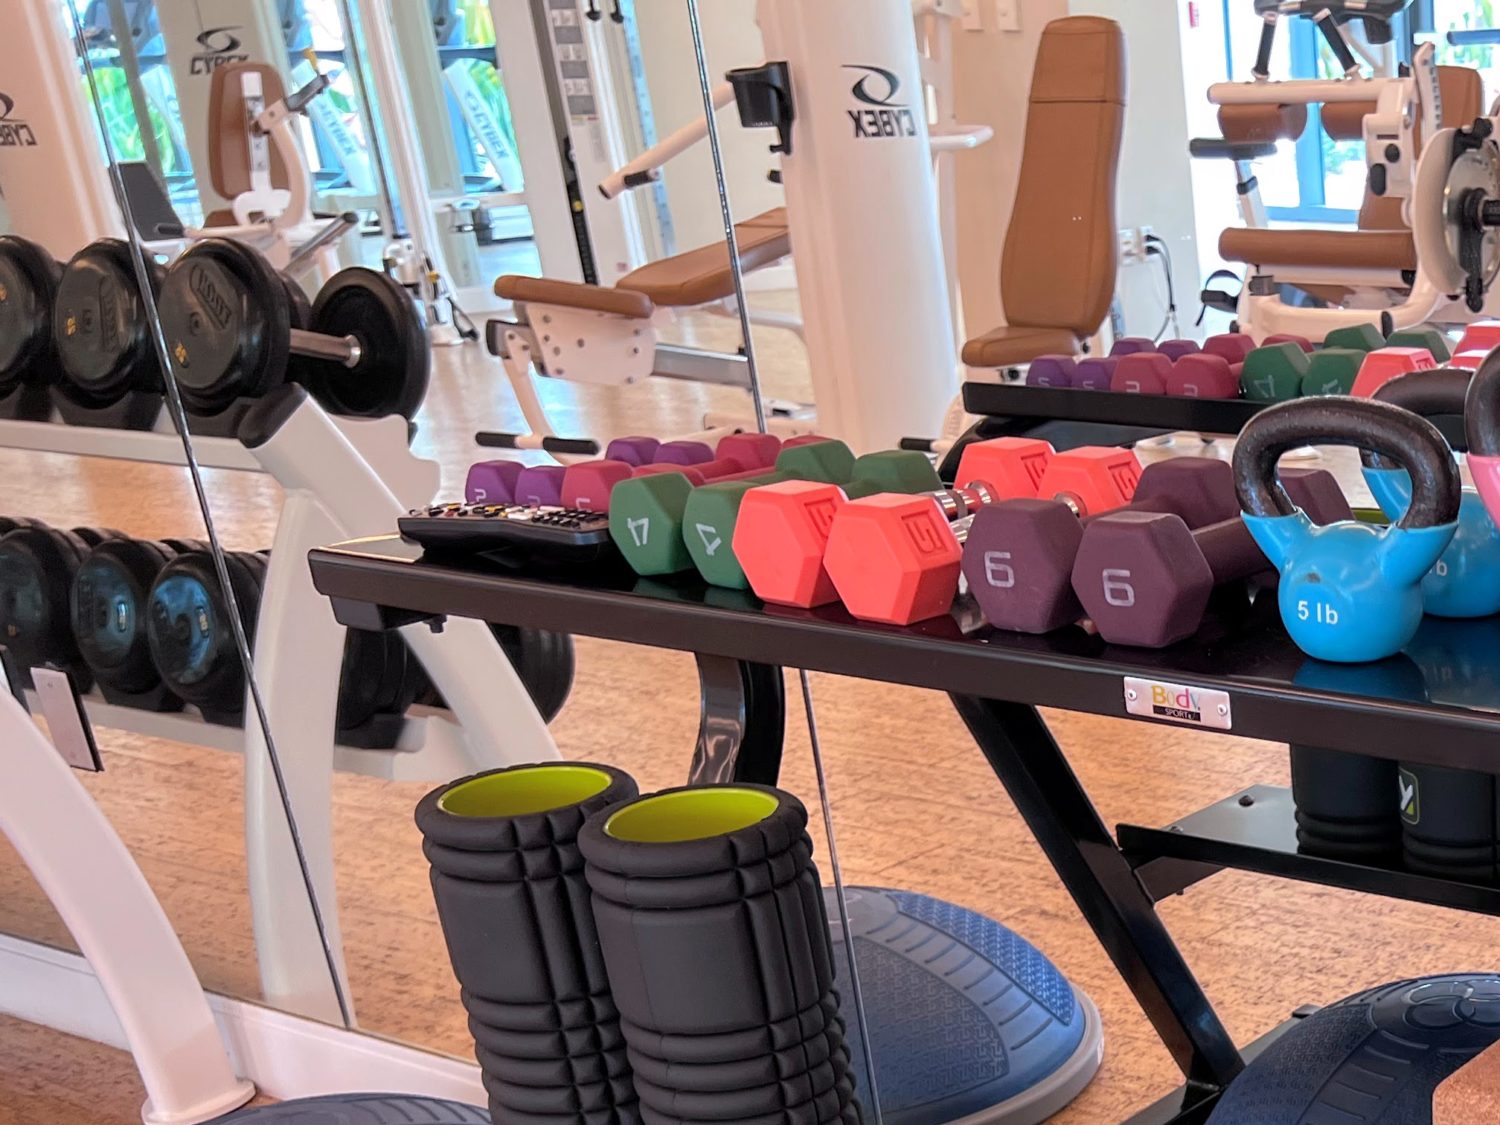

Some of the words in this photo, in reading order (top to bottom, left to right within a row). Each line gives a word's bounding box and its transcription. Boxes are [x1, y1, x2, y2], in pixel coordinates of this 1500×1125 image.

[983, 550, 1015, 589] 6
[1102, 568, 1136, 608] 6
[1297, 600, 1309, 620] 5
[1316, 602, 1339, 625] lb
